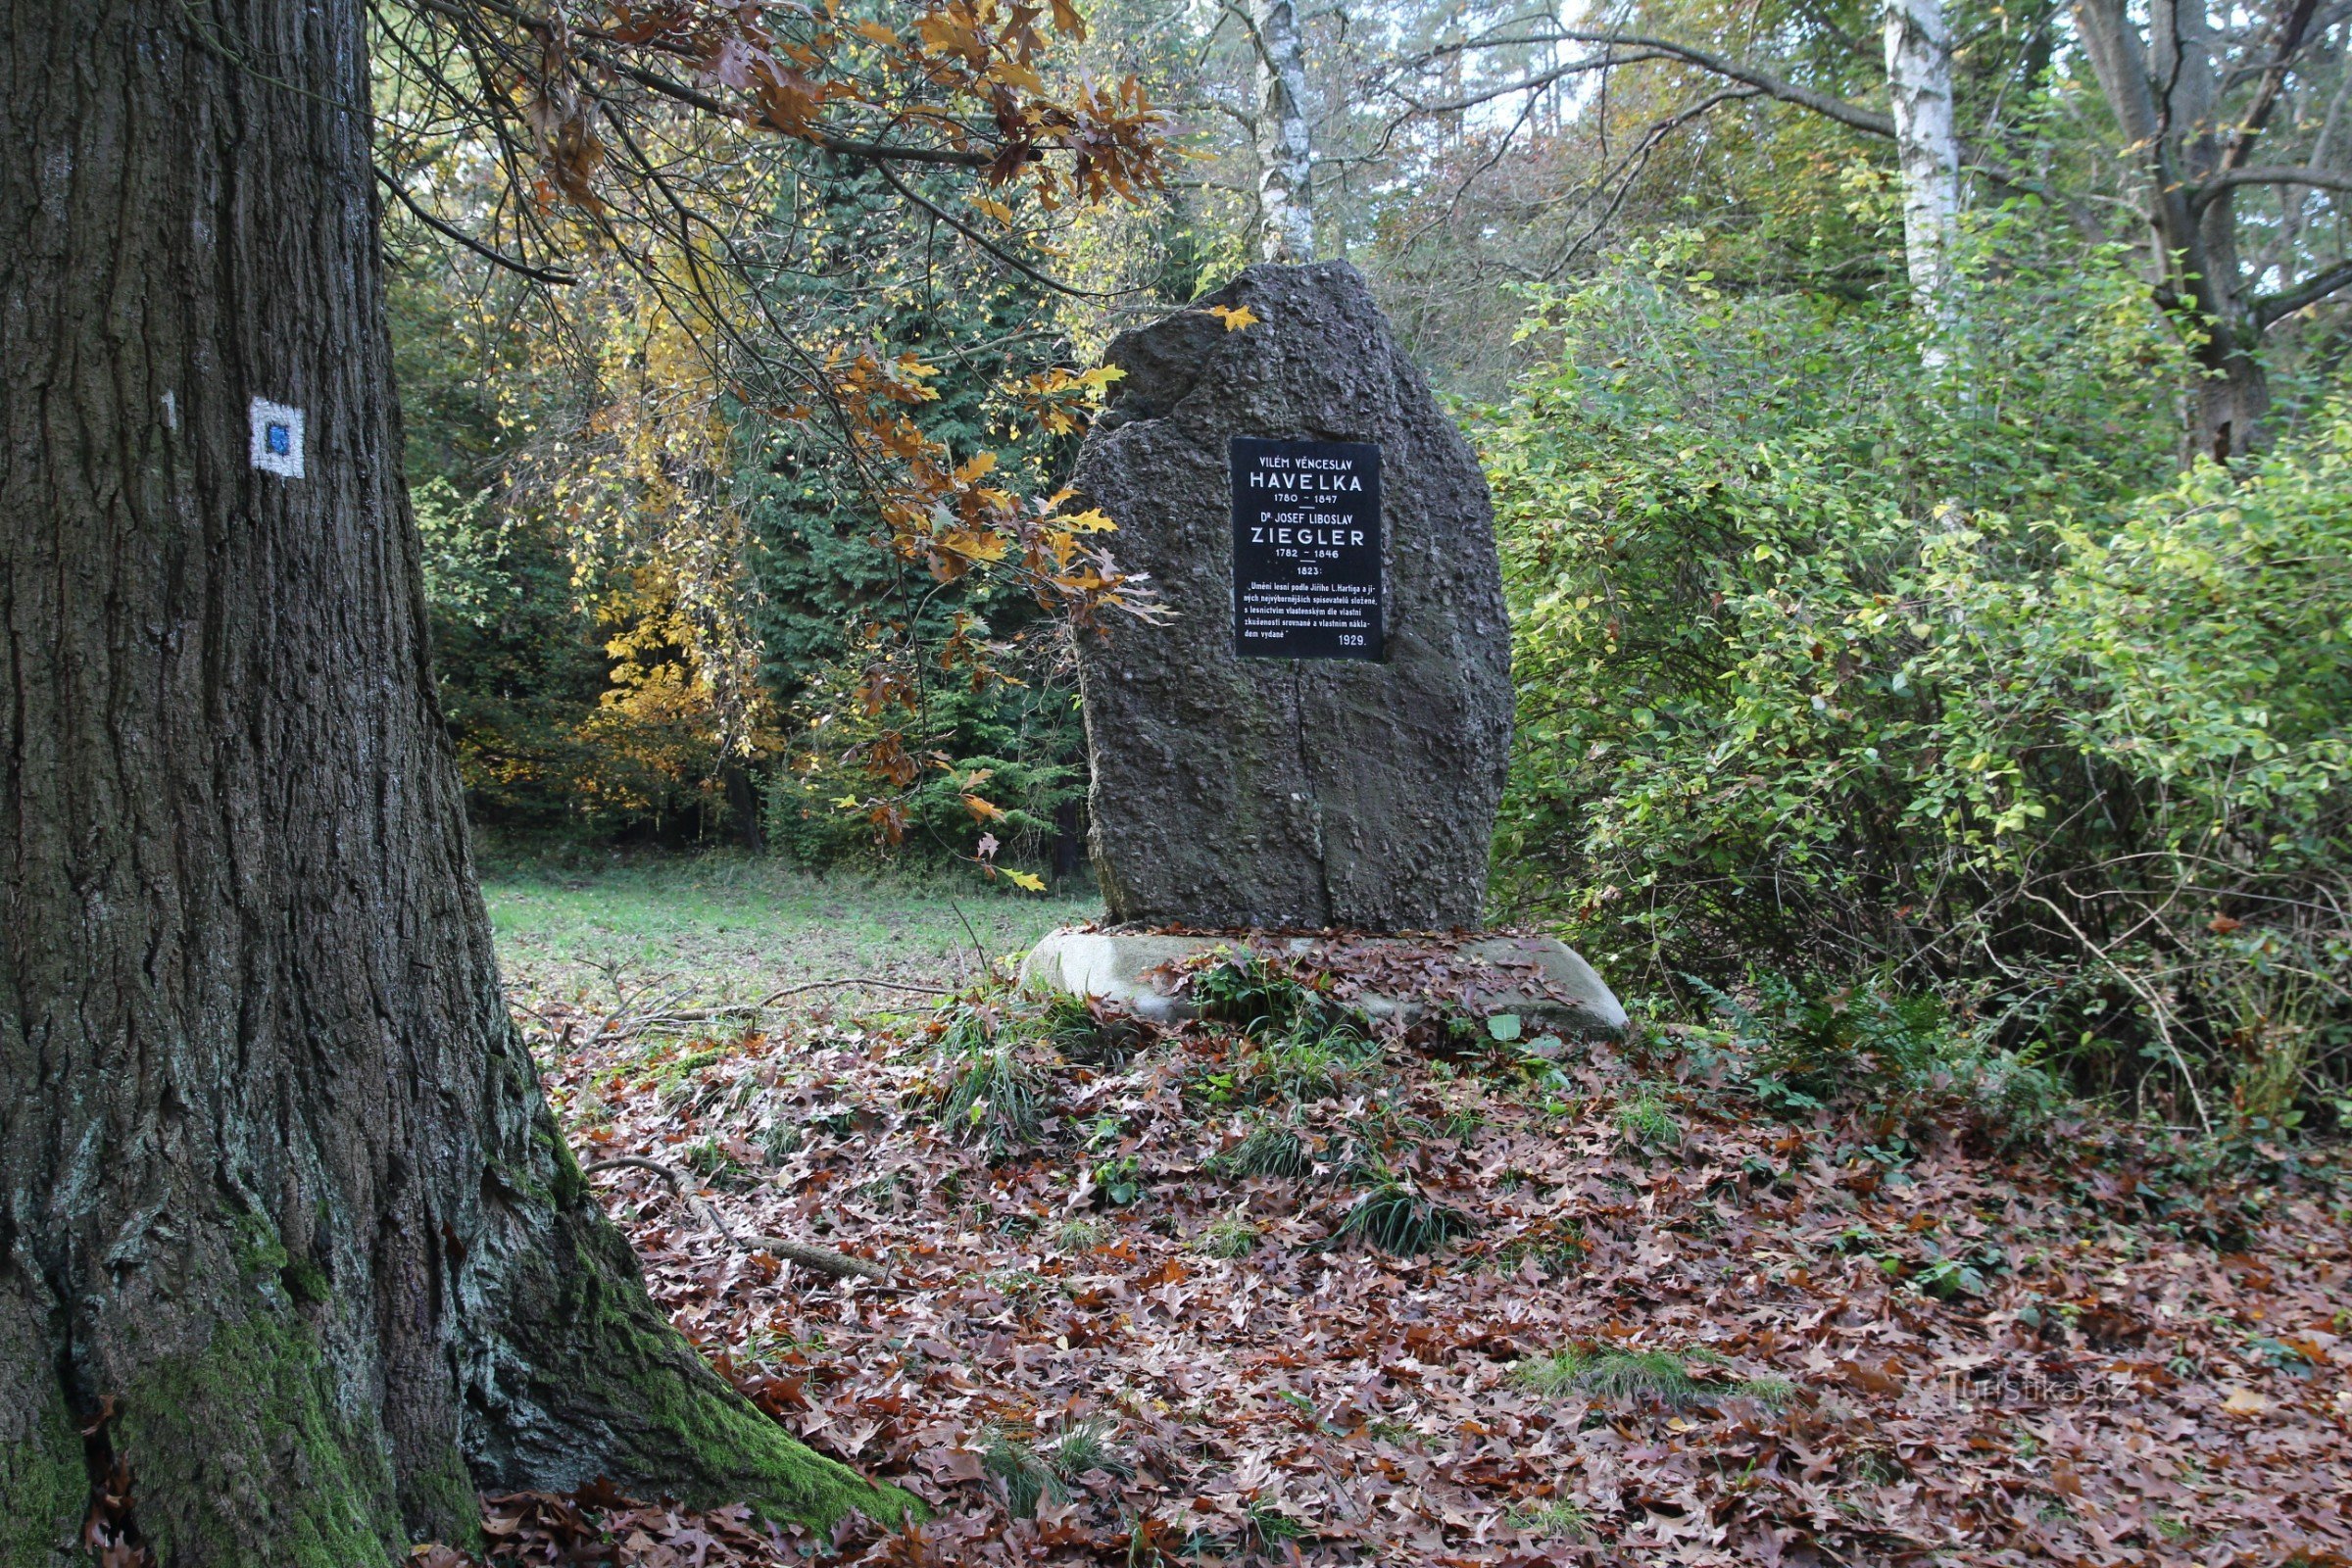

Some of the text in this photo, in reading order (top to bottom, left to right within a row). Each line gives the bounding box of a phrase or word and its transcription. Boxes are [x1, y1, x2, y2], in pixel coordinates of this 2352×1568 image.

[1259, 455, 1353, 470] VILÉM VĚNCESLAV
[1250, 471, 1363, 492] HAVELKA
[1274, 493, 1298, 503] 1780
[1314, 494, 1338, 504] 1847
[1275, 513, 1305, 523] JOSEF
[1309, 514, 1353, 525] LIBOSLAV
[1250, 526, 1364, 546] ZIEGLER
[1276, 548, 1298, 558] 1782
[1314, 550, 1339, 559] 1846
[1298, 566, 1323, 575] 1823:
[1292, 583, 1309, 592] podle
[1310, 583, 1330, 592] Jiřího
[1243, 594, 1259, 603] ných
[1260, 594, 1311, 605] nejvýbornějších
[1313, 596, 1349, 605] spisovatelů
[1286, 606, 1326, 616] vlastenským
[1327, 607, 1338, 615] dle
[1339, 608, 1362, 616] vlastní
[1244, 617, 1281, 626] zkušenosti
[1282, 618, 1311, 627] srovnané
[1244, 629, 1259, 638] dem
[1338, 634, 1367, 646] 1929.
